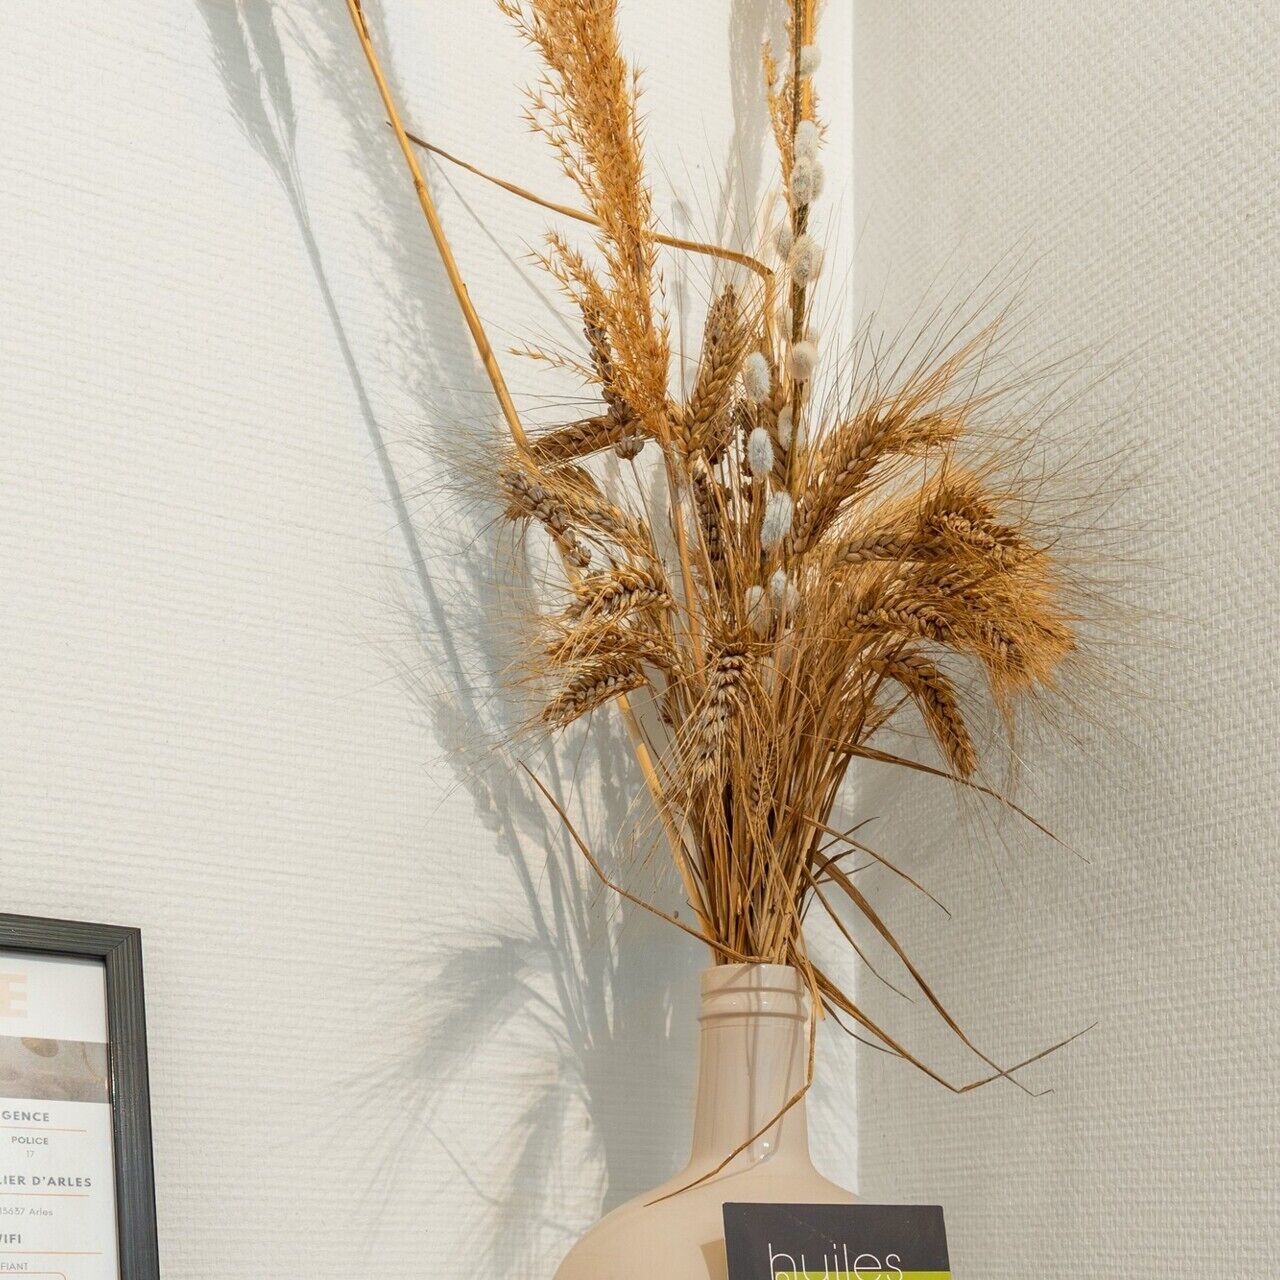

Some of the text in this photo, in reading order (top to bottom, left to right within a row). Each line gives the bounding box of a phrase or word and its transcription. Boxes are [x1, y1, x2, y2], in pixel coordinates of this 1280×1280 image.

[11, 1136, 49, 1146] POLICE
[26, 1150, 35, 1158] 17
[32, 1175, 92, 1188] D'ARLES
[29, 1206, 54, 1217] Arles
